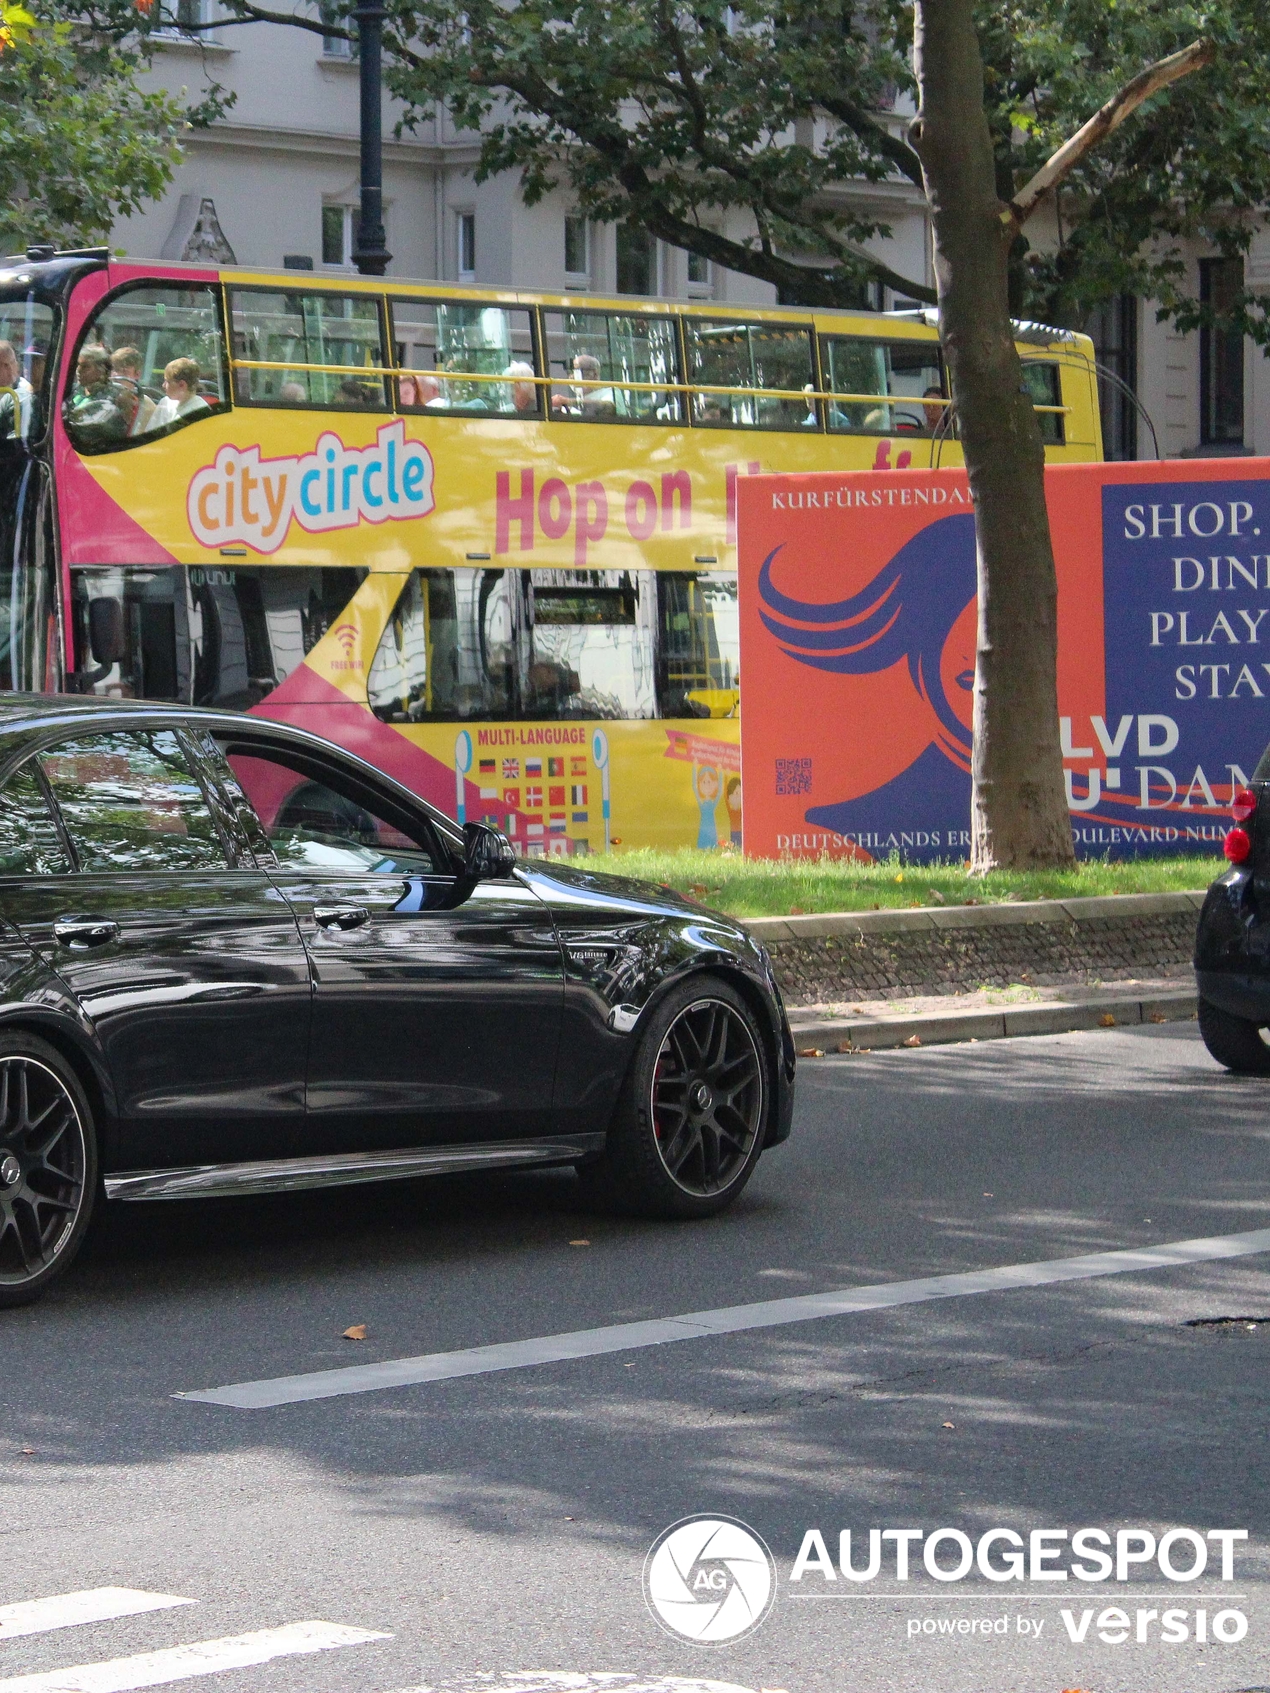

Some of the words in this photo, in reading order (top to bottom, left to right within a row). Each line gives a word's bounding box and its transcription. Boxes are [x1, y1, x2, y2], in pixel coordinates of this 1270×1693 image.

[198, 461, 288, 537] city
[300, 439, 425, 517] circle
[771, 486, 978, 510] KURFÜRSTENDA
[495, 467, 609, 566] Hop
[625, 468, 692, 541] on
[1124, 501, 1261, 540] SHOP.
[1171, 554, 1270, 592] DIN
[1148, 608, 1270, 647] PLAY
[330, 660, 348, 670] FREE
[1175, 662, 1270, 701] STA
[478, 727, 586, 746] MULTI-LANGUAGE
[1059, 714, 1180, 758] LVD
[776, 831, 942, 850] DEUTSCHLANDS
[1071, 825, 1179, 844] OULEVARD
